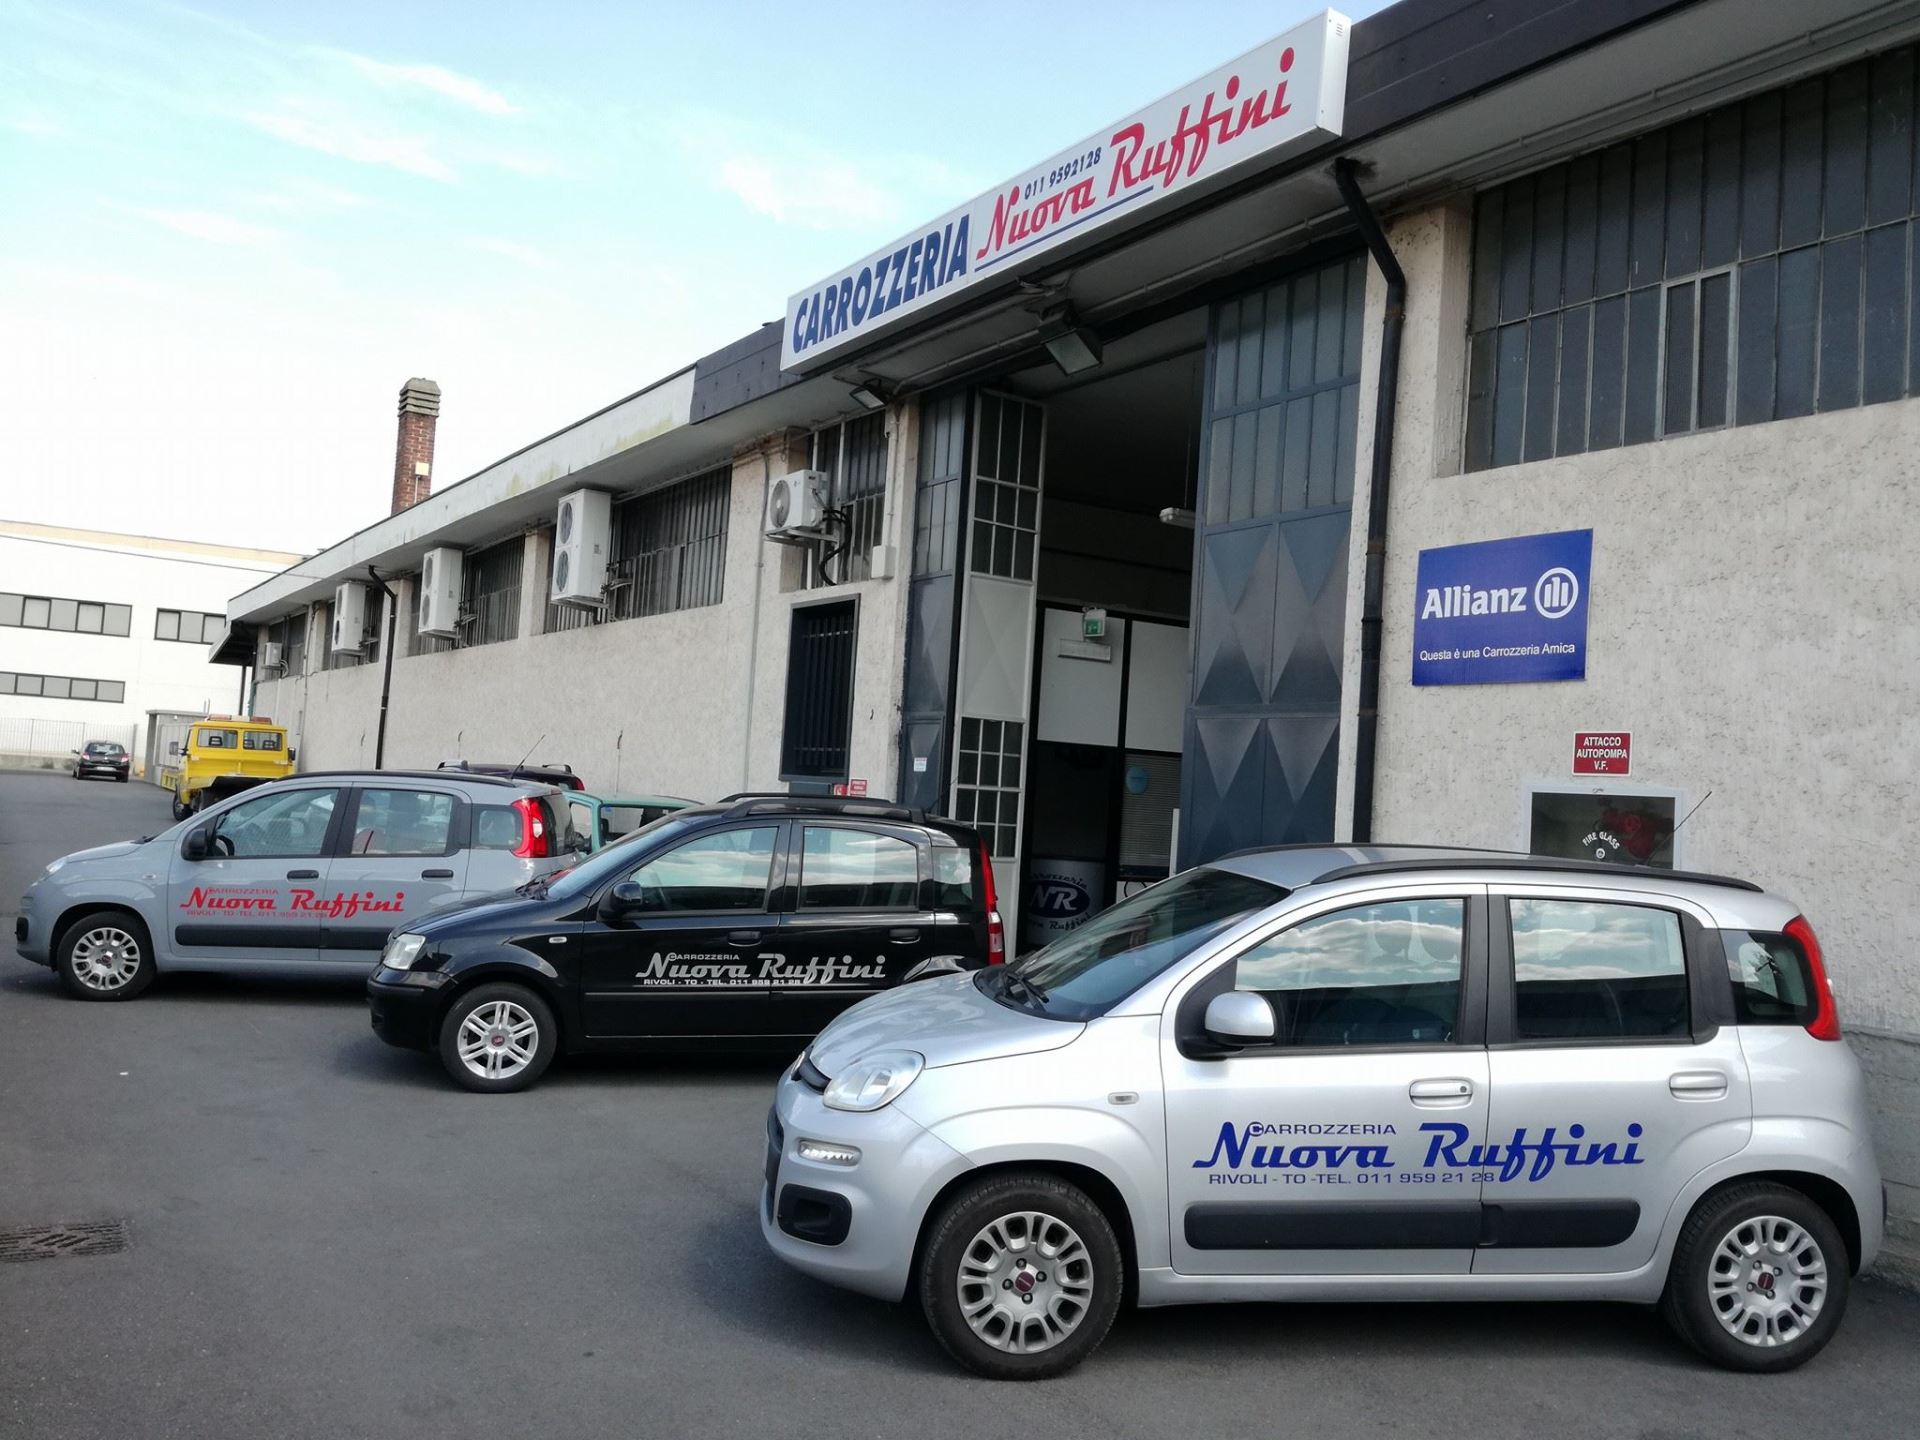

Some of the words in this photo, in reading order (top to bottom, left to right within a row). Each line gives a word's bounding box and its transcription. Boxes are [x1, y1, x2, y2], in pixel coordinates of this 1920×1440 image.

[975, 185, 1095, 260] Nuova
[1109, 47, 1294, 195] Ruffini
[1024, 177, 1046, 200] 011
[1049, 147, 1102, 187] 9592128
[793, 214, 970, 353] CARROZZERIA
[1422, 585, 1527, 620] Allianz
[1420, 650, 1452, 661] Questa
[1462, 649, 1480, 659] una
[1483, 644, 1540, 658] Carrozzeria
[1542, 642, 1575, 655] Amica
[1583, 737, 1621, 747] ATTACCO
[1576, 749, 1628, 759] AUTOPOMPA
[1594, 761, 1608, 770] V.F.
[1582, 832, 1597, 846] FIRE
[1599, 831, 1620, 850] GLASS
[180, 887, 277, 909] Nuova
[289, 888, 405, 918] Ruffini
[1028, 884, 1078, 911] NR
[635, 952, 751, 978] Nuova
[757, 953, 886, 984] Ruffini
[668, 952, 740, 961] CARROZZERIA
[1248, 1122, 1397, 1137] CARROZZERIA
[1192, 1121, 1396, 1169] Nuova
[1418, 1122, 1645, 1182] Ruffini
[1209, 1173, 1268, 1185] RIVOLI
[1282, 1173, 1306, 1185] TO
[1357, 1173, 1392, 1185] 011
[1400, 1173, 1437, 1185] 959
[1442, 1173, 1464, 1185] 21
[1471, 1172, 1495, 1184] 28
